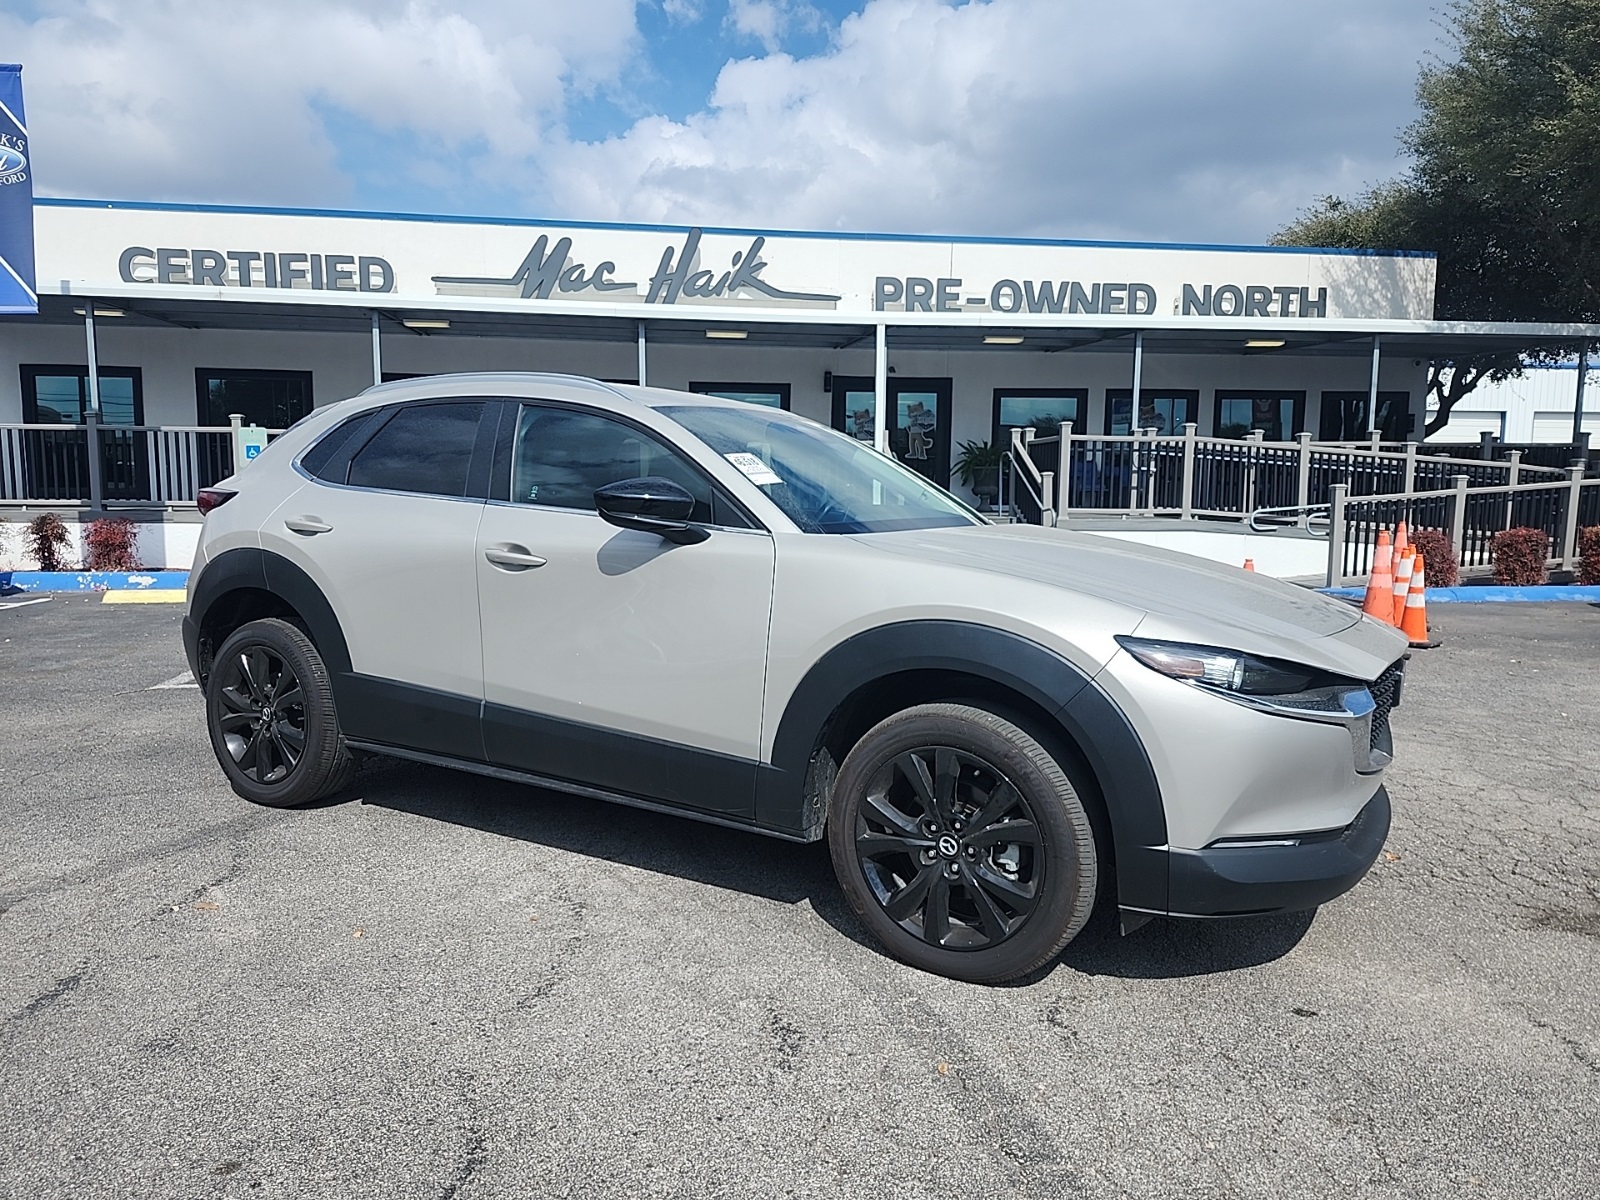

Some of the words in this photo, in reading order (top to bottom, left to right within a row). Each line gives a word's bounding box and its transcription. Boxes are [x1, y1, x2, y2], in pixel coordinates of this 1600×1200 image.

[118, 246, 395, 293] CERTIFIED
[431, 234, 638, 300] Mac
[643, 227, 842, 305] Haik
[873, 276, 1156, 316] PRE-OWNED
[1182, 283, 1328, 318] NORTH
